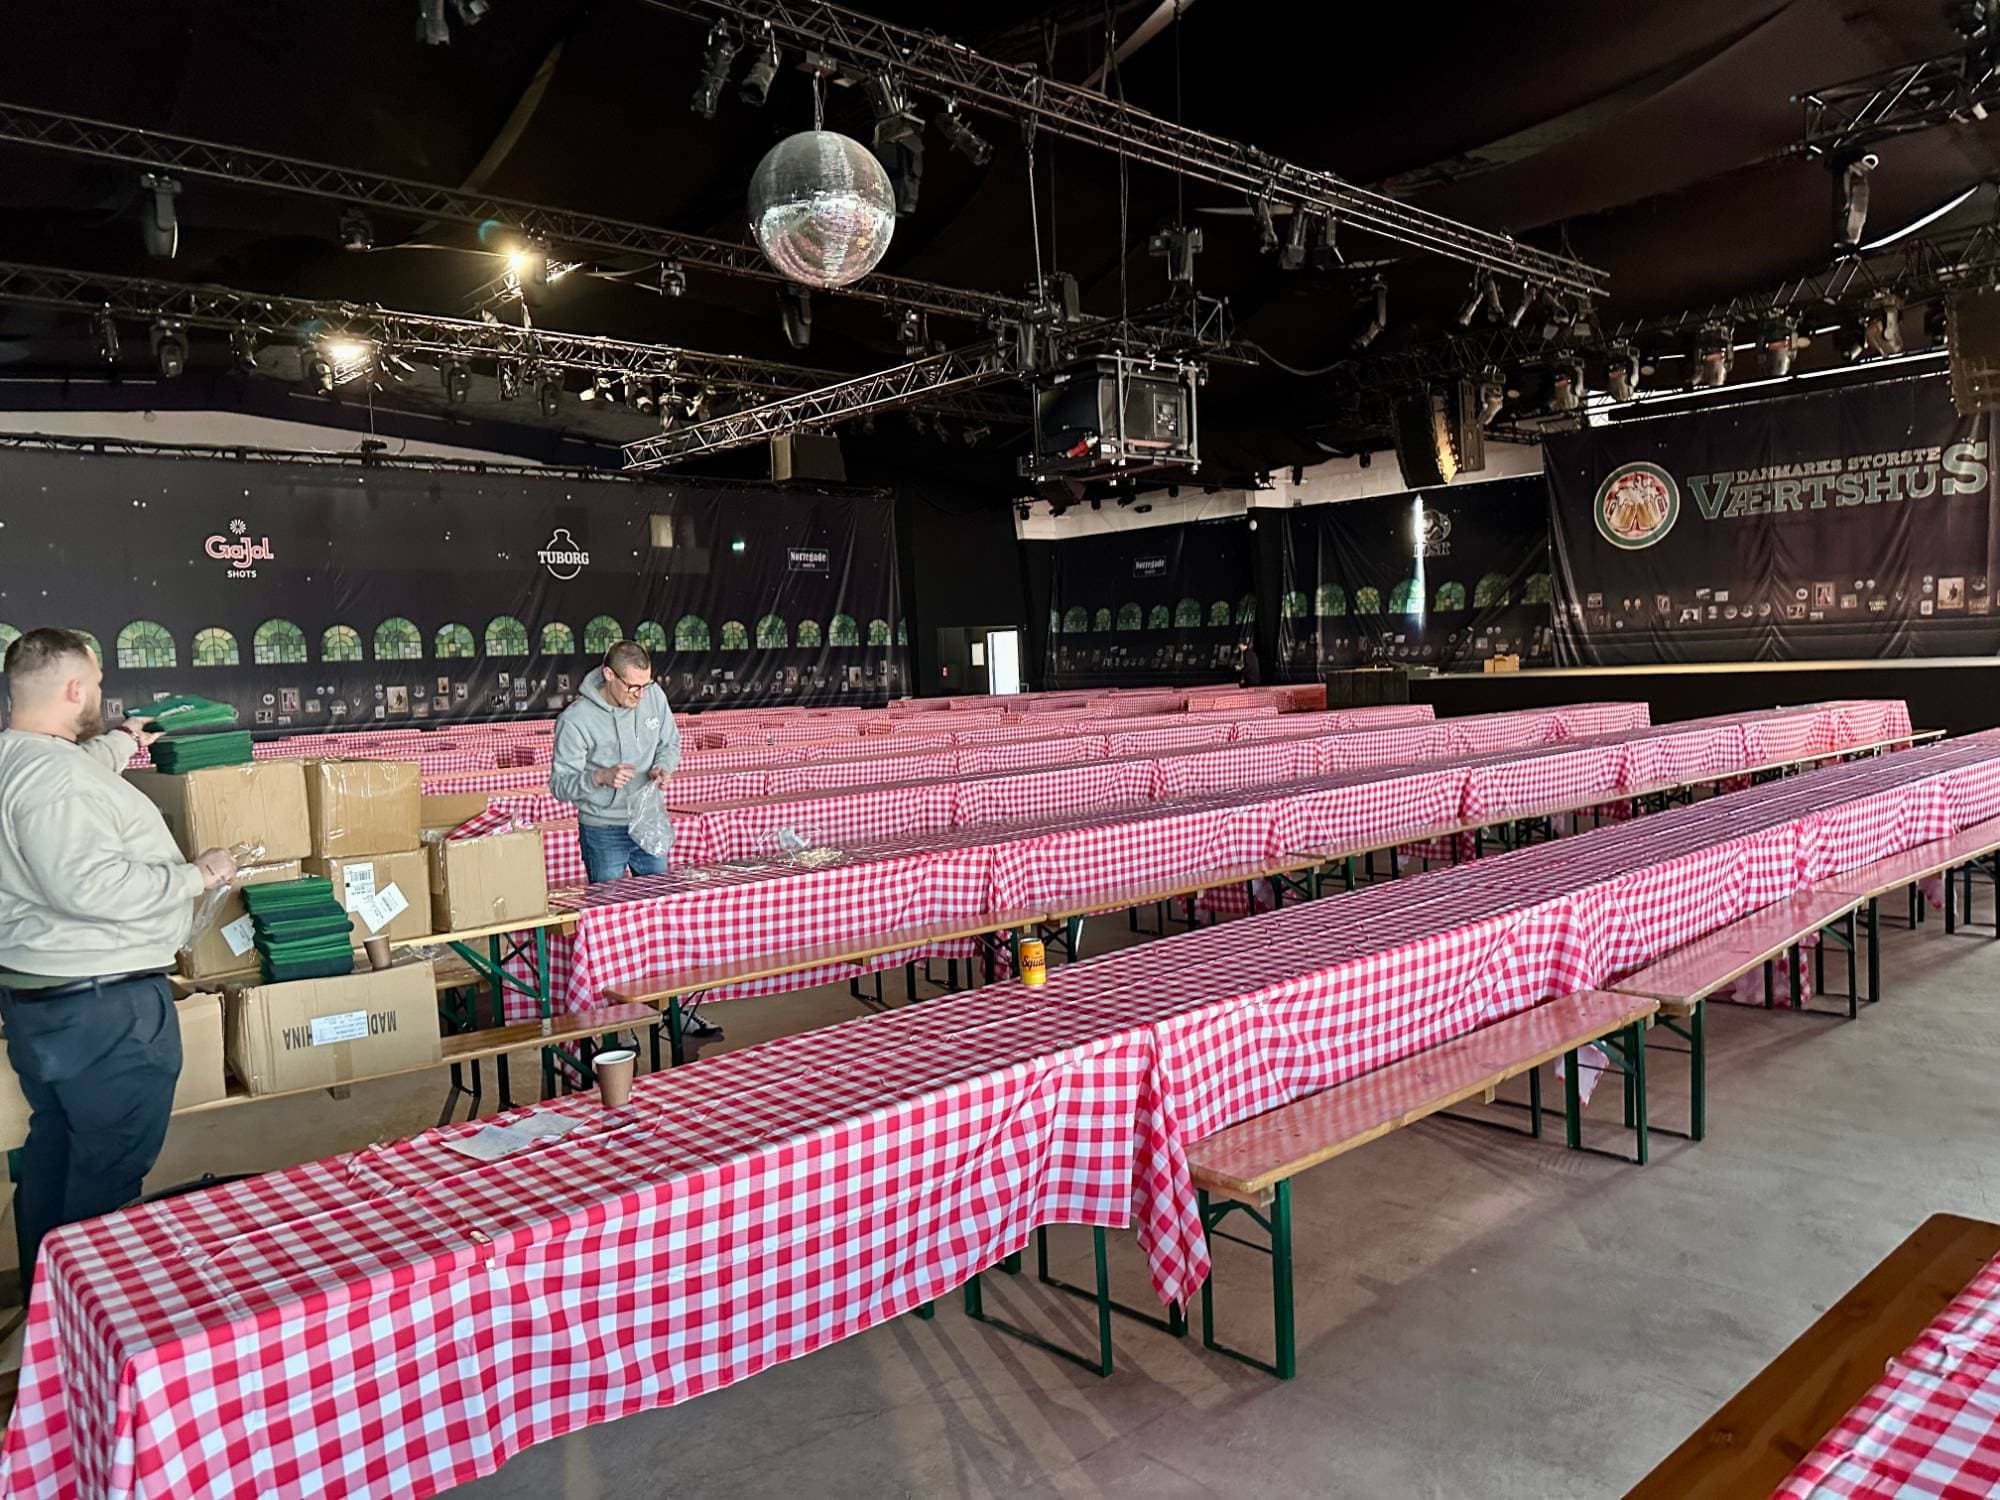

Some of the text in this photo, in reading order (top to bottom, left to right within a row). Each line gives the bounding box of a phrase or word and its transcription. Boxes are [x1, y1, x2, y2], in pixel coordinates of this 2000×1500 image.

[1687, 441, 1988, 520] VÆRTSHUS
[1737, 458, 1842, 483] DANMARKS
[537, 551, 589, 565] TUBORG
[227, 569, 257, 578] SHOTS
[367, 1010, 397, 1036] MAD
[282, 1025, 313, 1050] HINA
